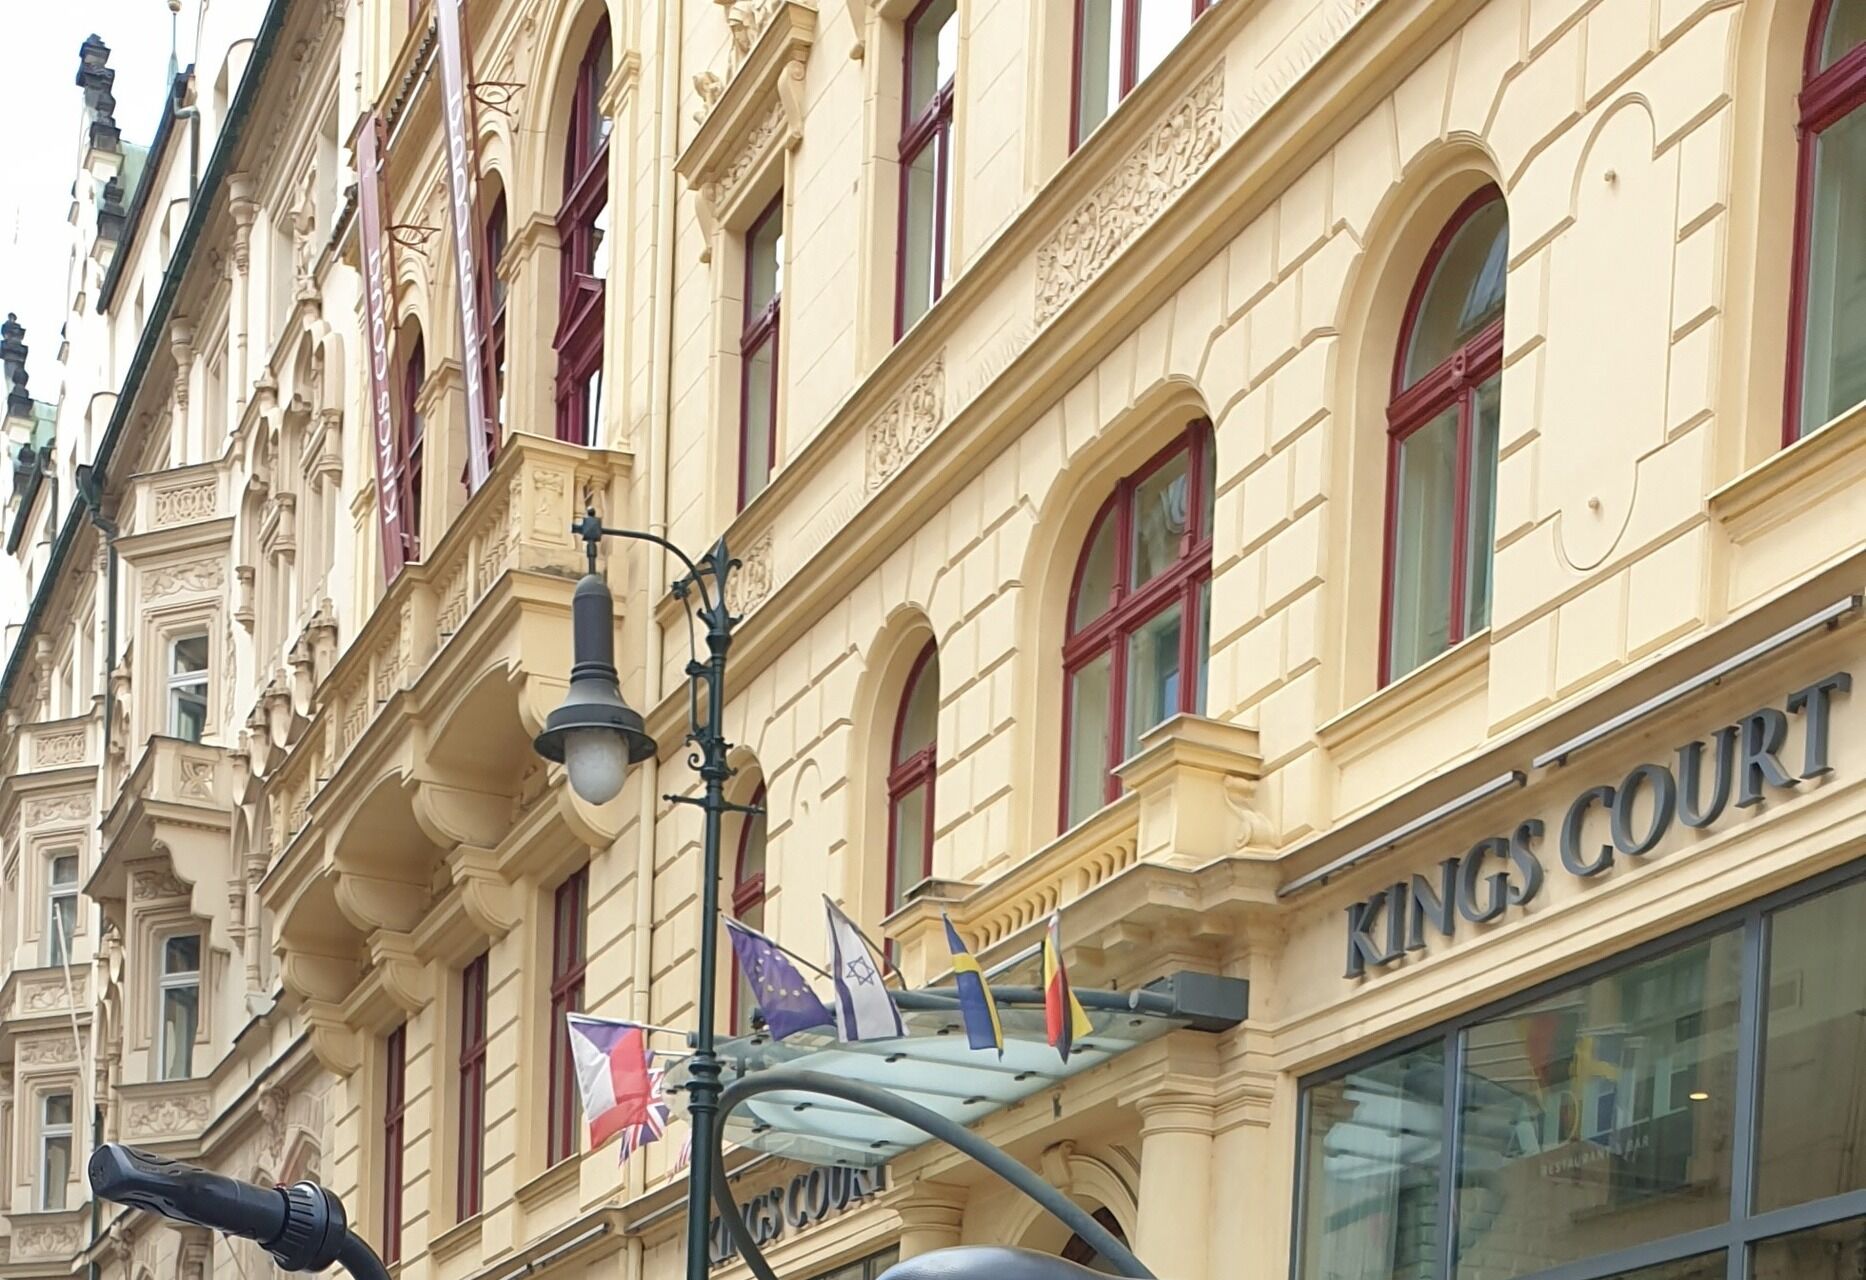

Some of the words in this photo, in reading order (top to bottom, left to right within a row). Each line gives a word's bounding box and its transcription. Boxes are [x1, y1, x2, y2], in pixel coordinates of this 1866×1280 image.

[450, 91, 468, 240] COURT
[369, 248, 387, 382] COURT
[462, 250, 479, 398] KINGS
[377, 391, 397, 525] KINGS
[1343, 818, 1544, 979] KINGS
[1560, 672, 1852, 877] COURT
